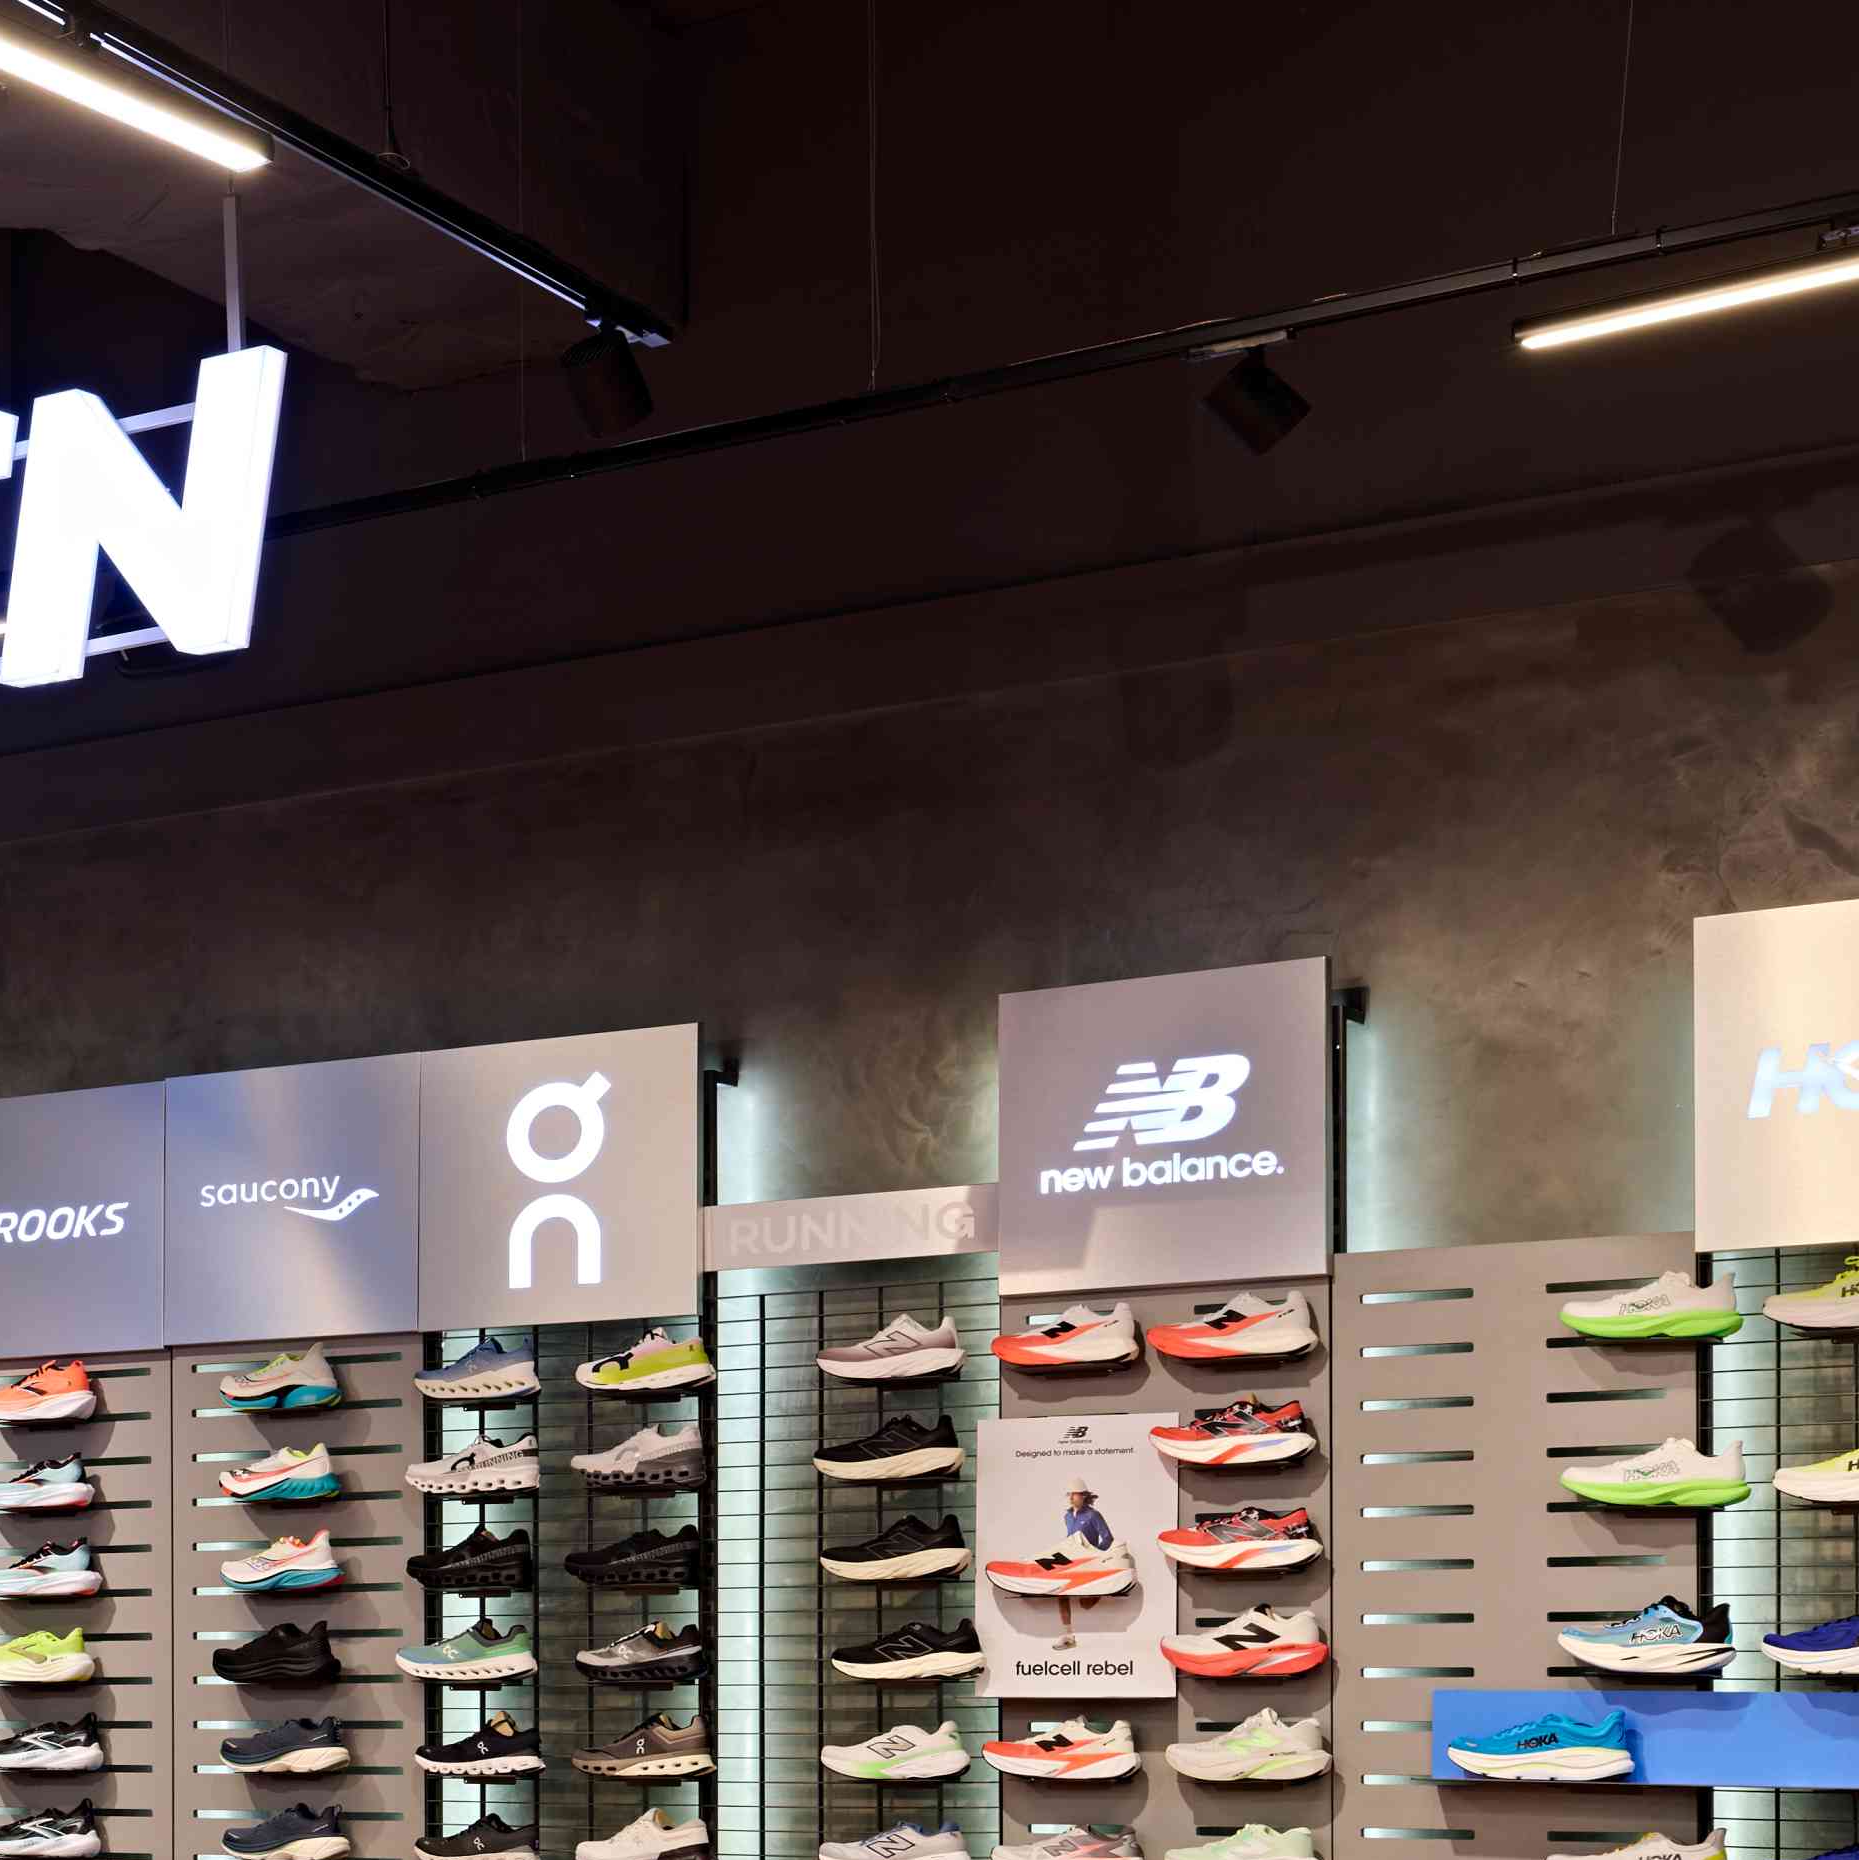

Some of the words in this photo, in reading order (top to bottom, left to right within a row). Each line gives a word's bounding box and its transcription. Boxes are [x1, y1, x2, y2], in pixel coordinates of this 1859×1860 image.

[1040, 1164, 1114, 1194] new
[199, 1175, 340, 1208] saucony
[729, 1200, 976, 1256] RUNNNG
[1015, 1449, 1052, 1458] Designed
[1631, 1623, 1683, 1643] HOKA
[1016, 1660, 1080, 1676] fuelcell
[1087, 1660, 1133, 1676] rebel
[1515, 1732, 1560, 1750] HOKA
